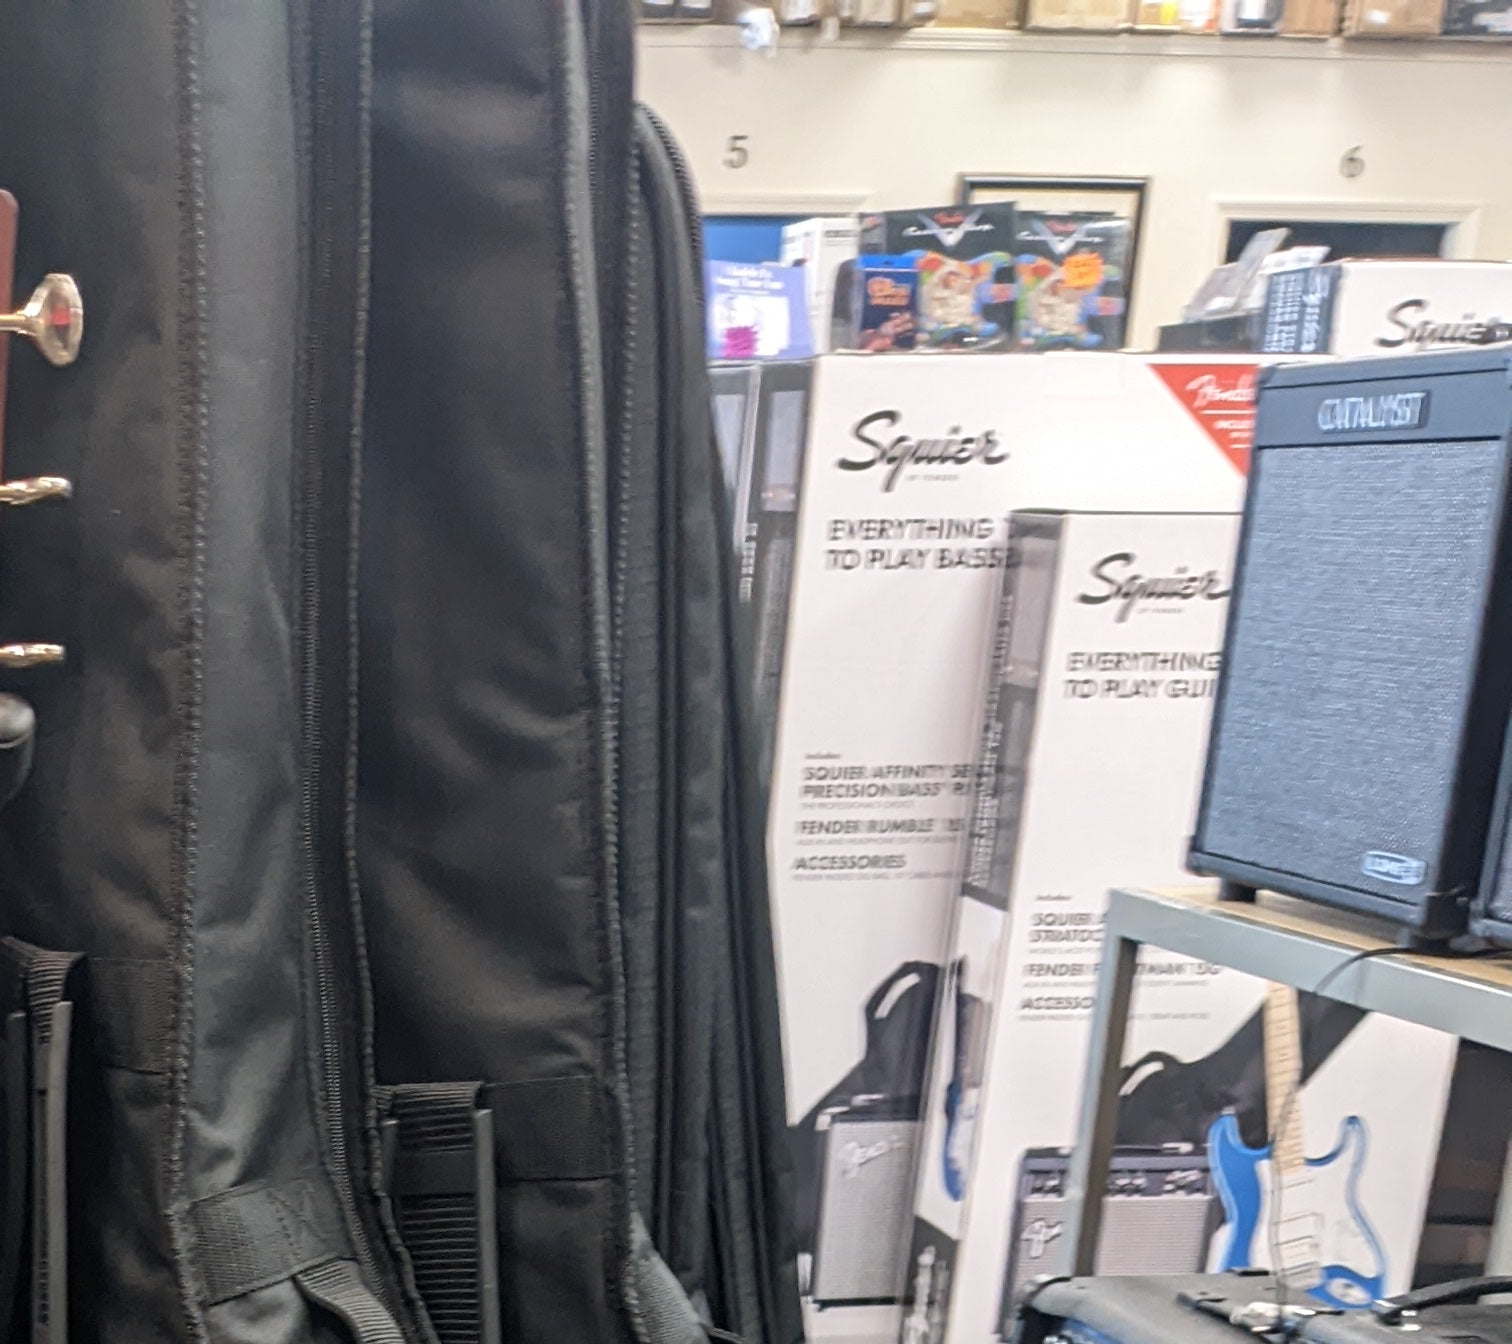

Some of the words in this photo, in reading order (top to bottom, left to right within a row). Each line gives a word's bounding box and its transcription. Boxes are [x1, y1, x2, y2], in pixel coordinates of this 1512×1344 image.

[721, 135, 749, 169] 5
[1339, 145, 1366, 178] 6
[1318, 392, 1428, 431] CATALYST
[836, 409, 1010, 492] Squier
[828, 518, 995, 540] EVERYTHING
[826, 548, 860, 569] TO
[865, 548, 930, 568] PLAY
[935, 548, 1005, 568] BASS
[1074, 552, 1231, 623] Squier
[1066, 652, 1222, 671] EVERYTHING
[1064, 679, 1098, 698] TO
[1102, 679, 1161, 698] PLAY
[1164, 679, 1216, 698] GUI
[799, 783, 894, 798] PRECISION
[793, 855, 907, 871] ACCESSORIES
[1028, 929, 1104, 943] STRATOC
[1020, 997, 1094, 1010] ACCESSO
